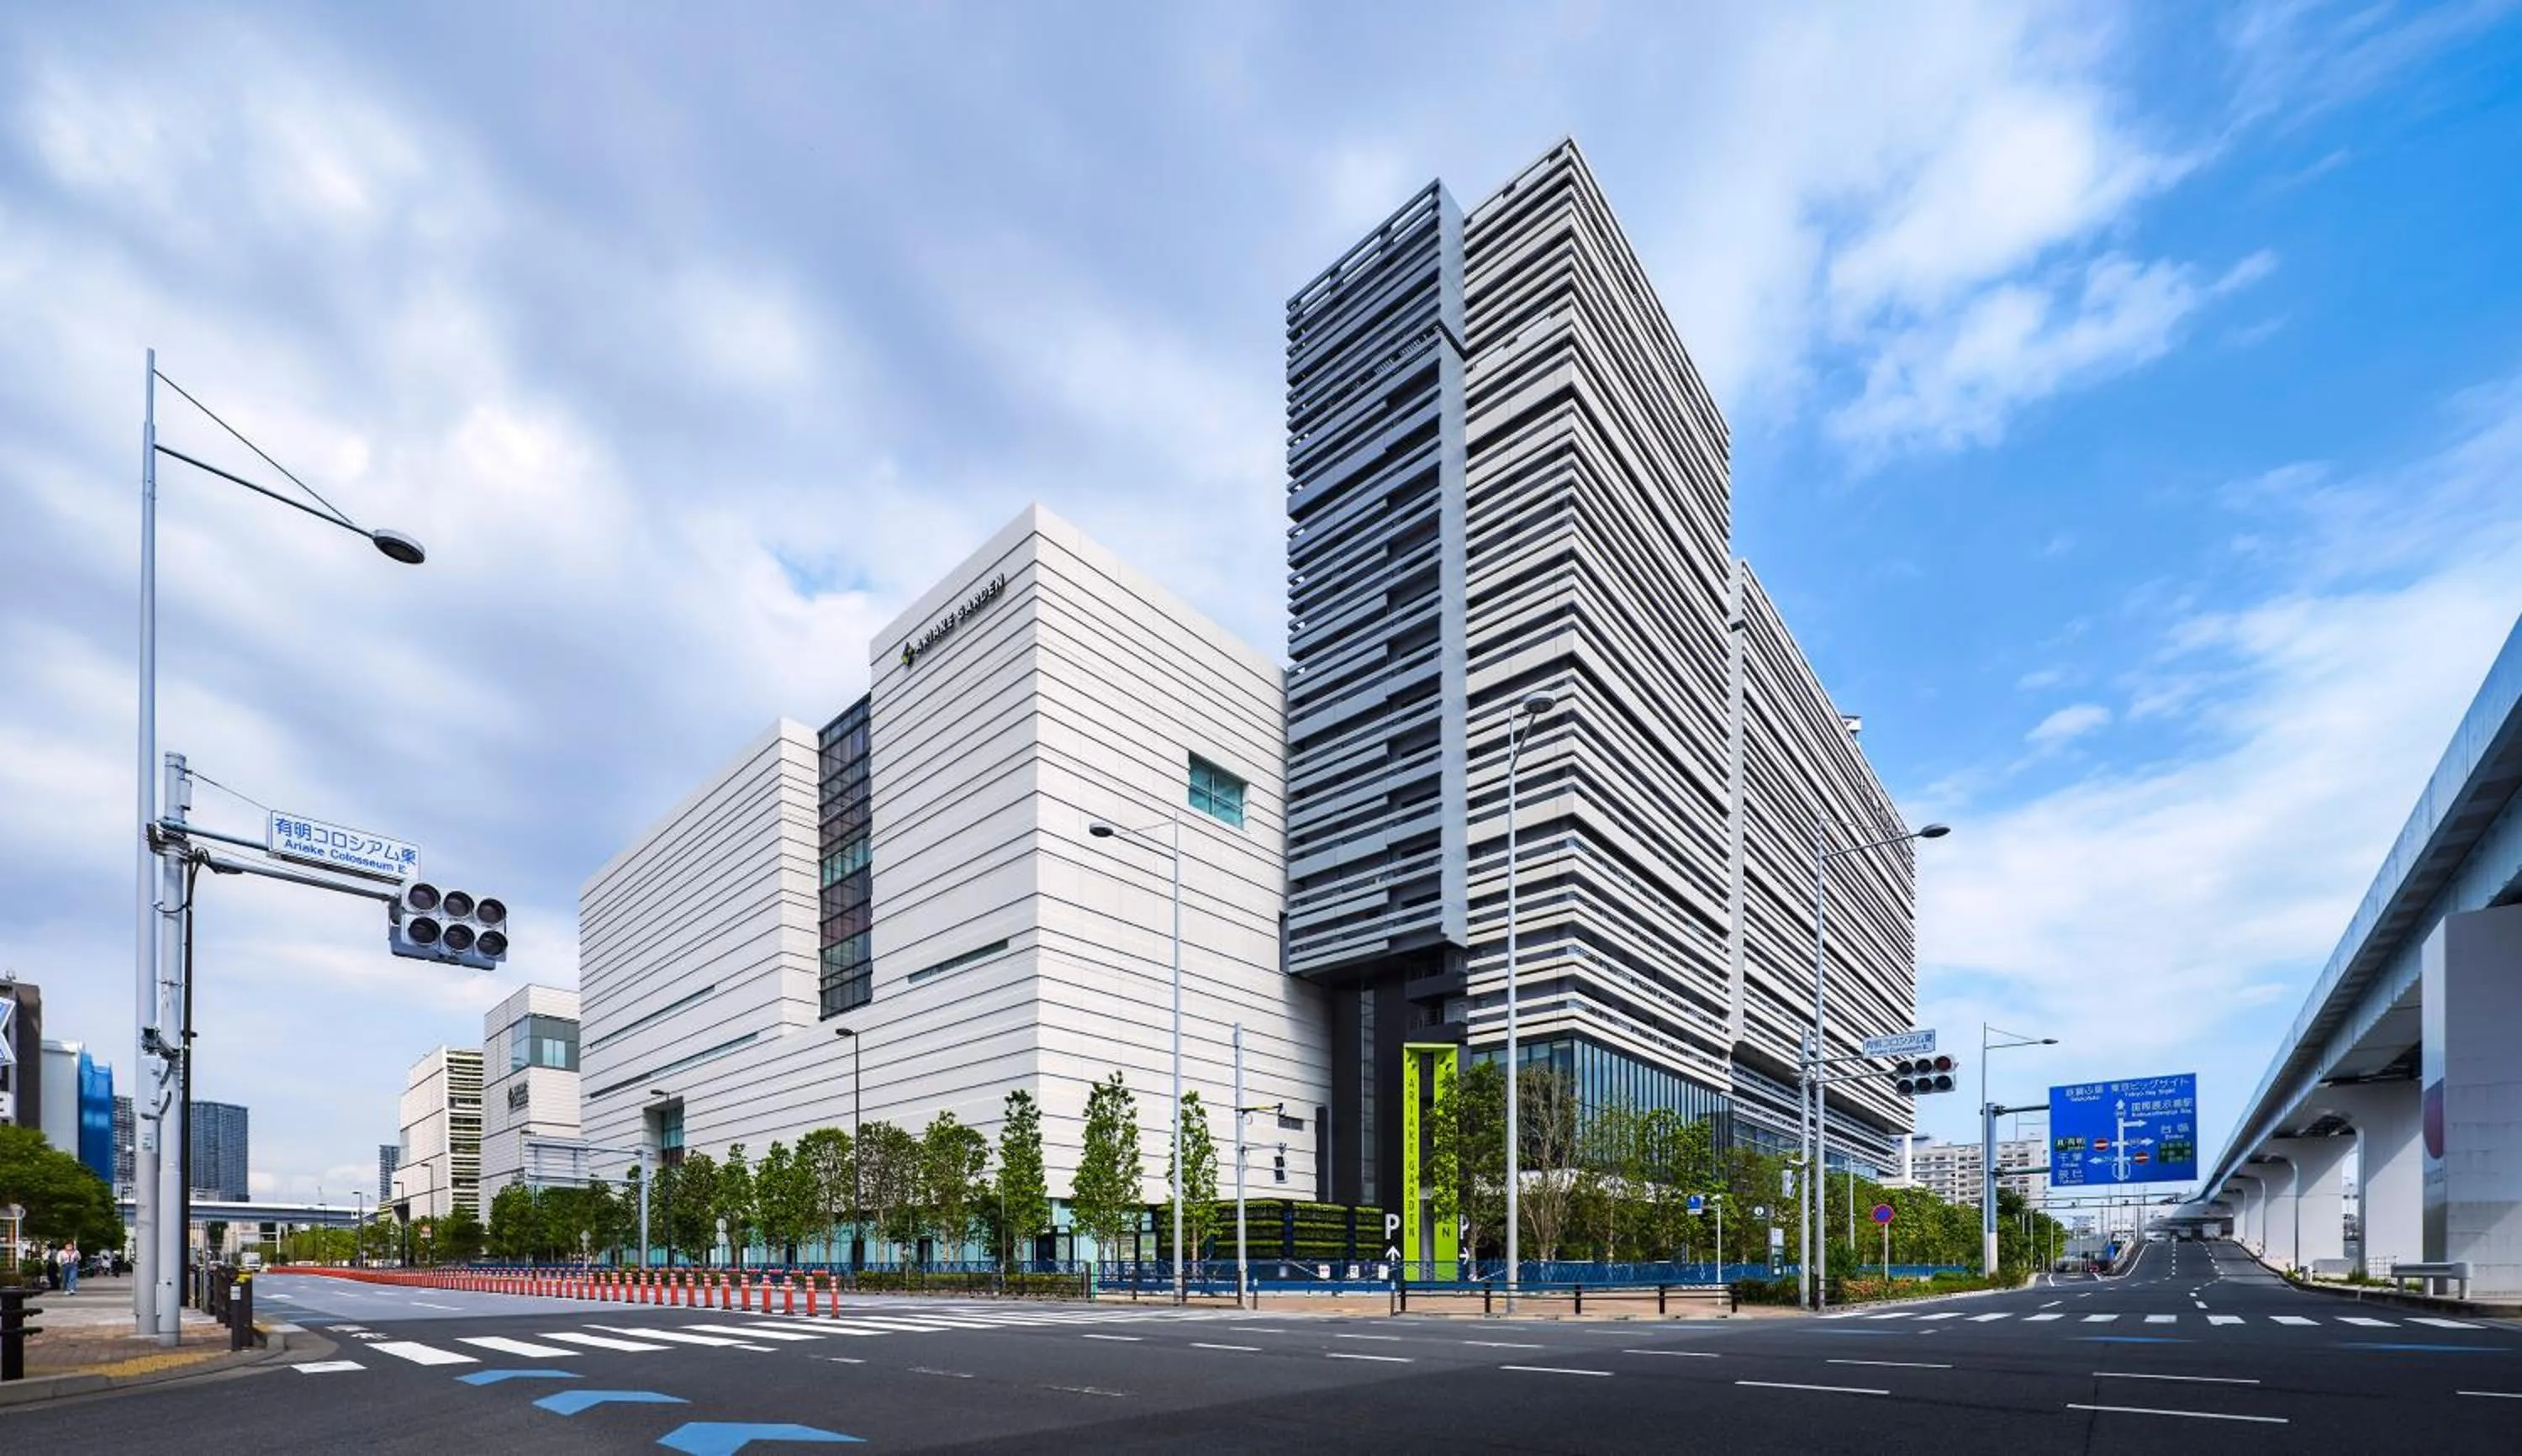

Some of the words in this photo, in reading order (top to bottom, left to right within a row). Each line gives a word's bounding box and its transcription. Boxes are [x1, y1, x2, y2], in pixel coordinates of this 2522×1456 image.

[915, 612, 956, 655] ARIAKE
[958, 572, 1005, 620] GARDEN
[275, 818, 416, 865] 有明コロシアム東
[284, 839, 325, 857] Ariake
[330, 850, 394, 872] Colosseum
[1385, 1213, 1401, 1240] P
